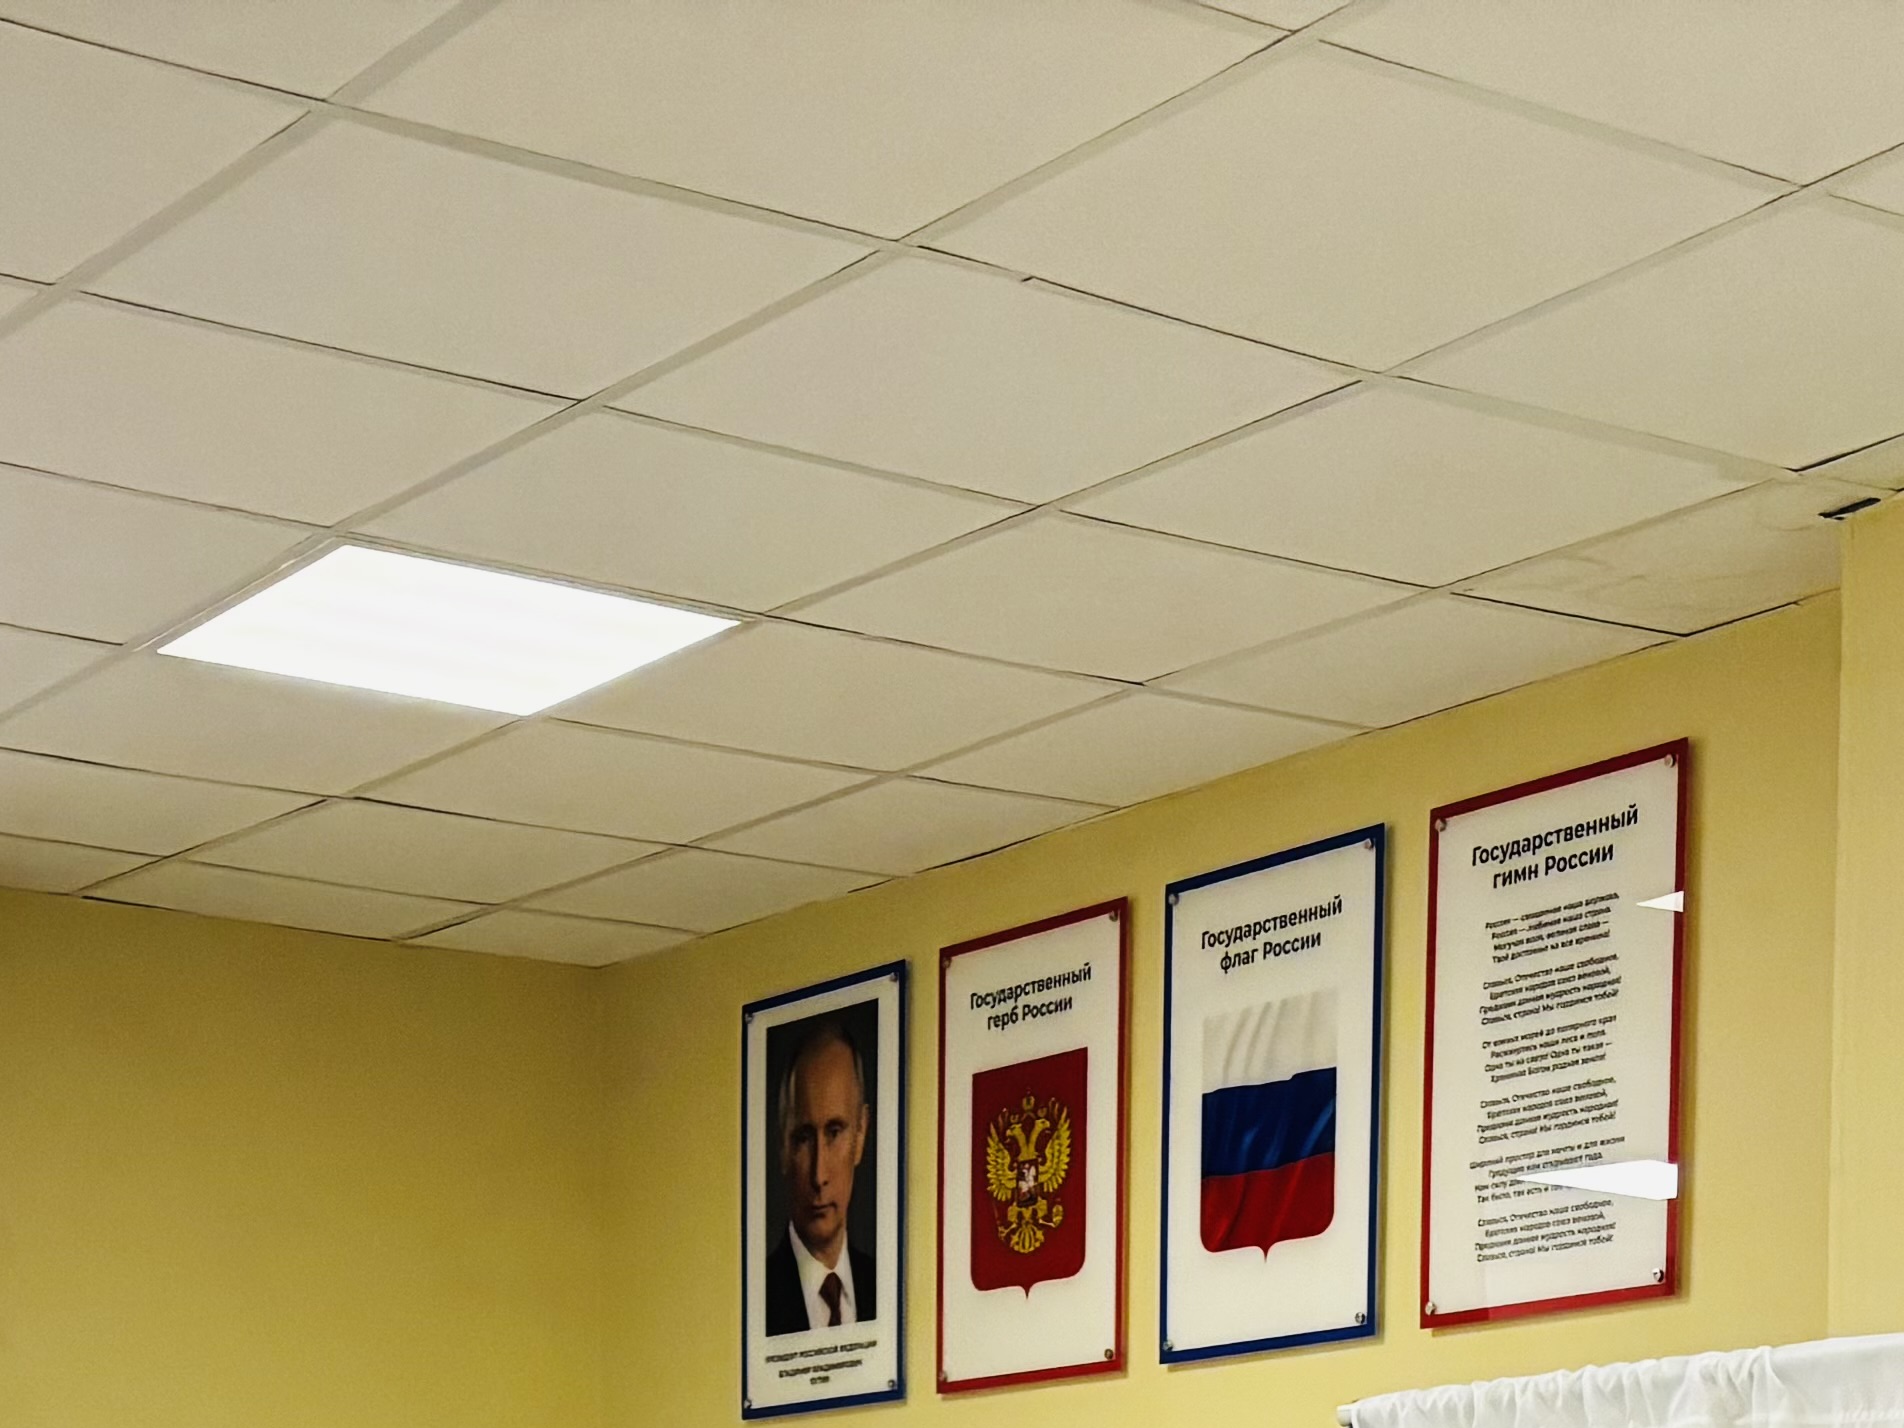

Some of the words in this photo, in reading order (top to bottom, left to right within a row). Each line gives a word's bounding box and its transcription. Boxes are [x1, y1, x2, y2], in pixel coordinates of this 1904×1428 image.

[1472, 803, 1639, 867] Государственный
[1493, 863, 1539, 889] гимн
[1544, 843, 1614, 876] России
[1201, 894, 1343, 949] Государственный
[1220, 948, 1259, 974] флаг
[1263, 932, 1322, 960] России
[970, 962, 1092, 1010] Государственный
[987, 1005, 1018, 1031] герб
[1022, 996, 1073, 1021] России
